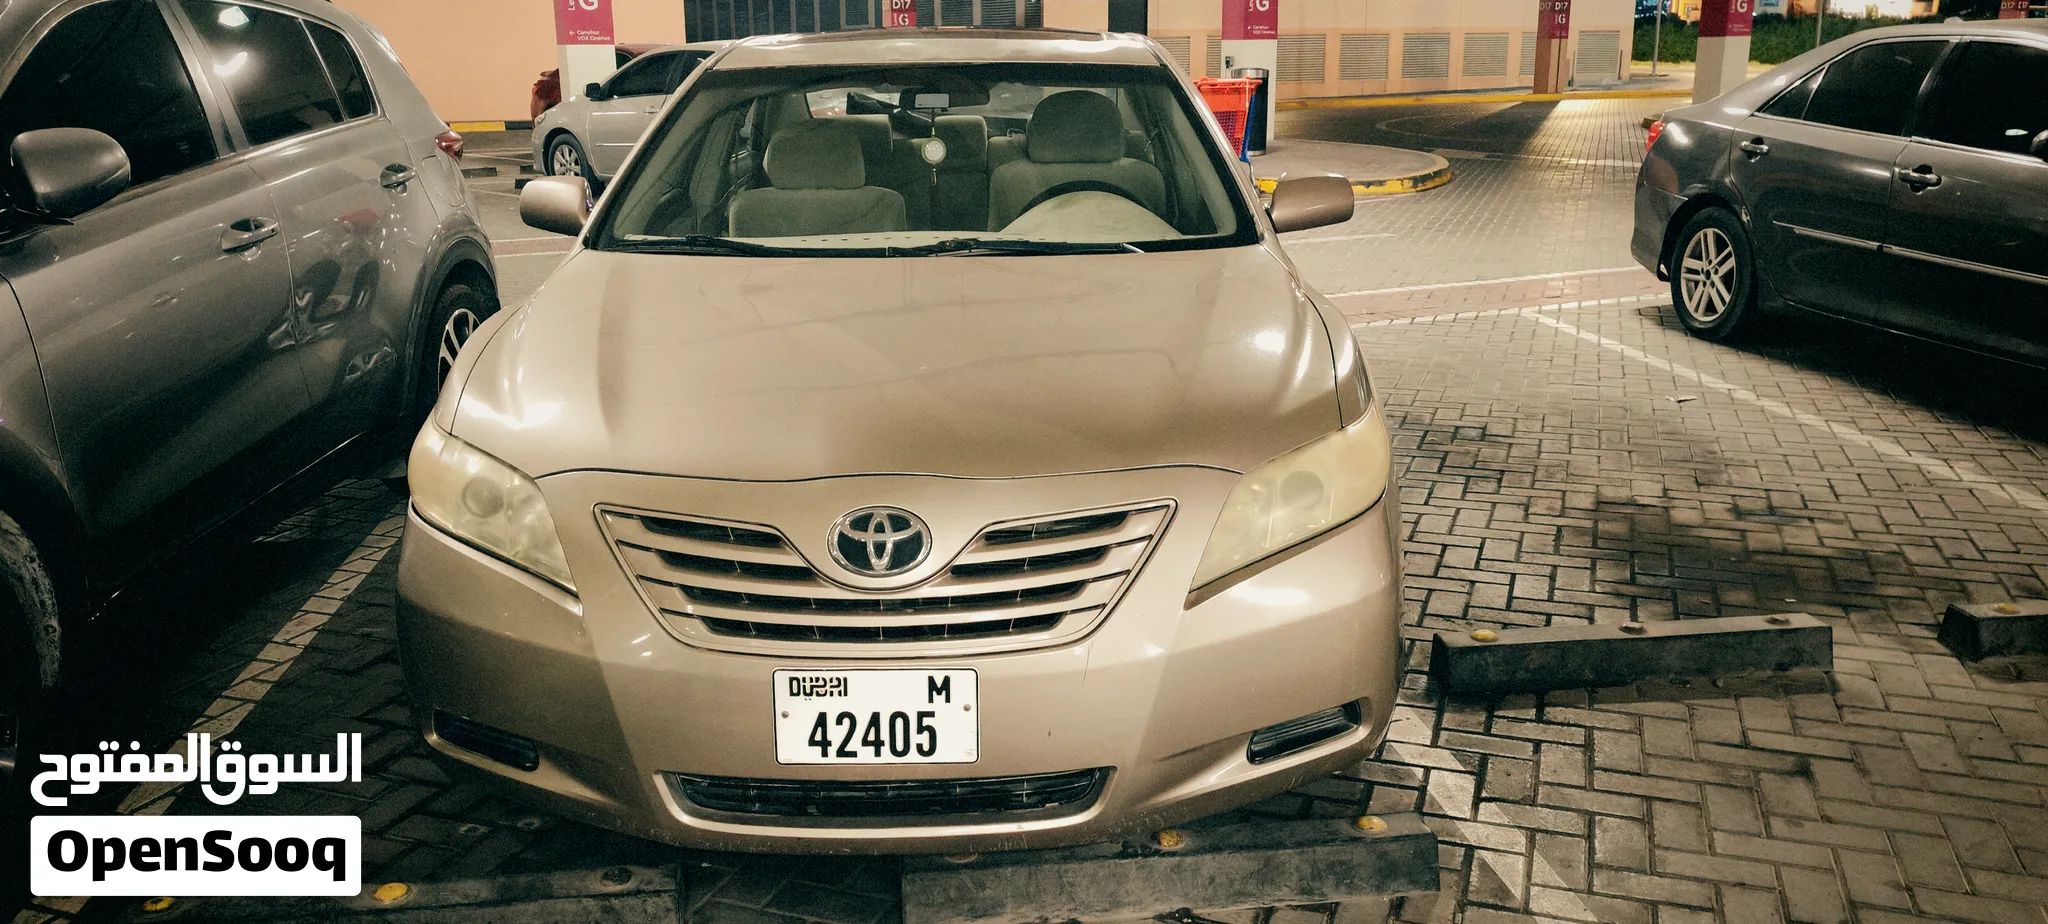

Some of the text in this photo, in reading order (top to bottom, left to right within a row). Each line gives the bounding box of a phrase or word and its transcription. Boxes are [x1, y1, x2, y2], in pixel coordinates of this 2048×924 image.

[892, 0, 911, 10] D17
[1256, 0, 1270, 12] G
[1555, 2, 1569, 11] D17
[898, 13, 909, 26] G
[789, 675, 951, 703] DUBAI M
[808, 711, 937, 758] 42405
